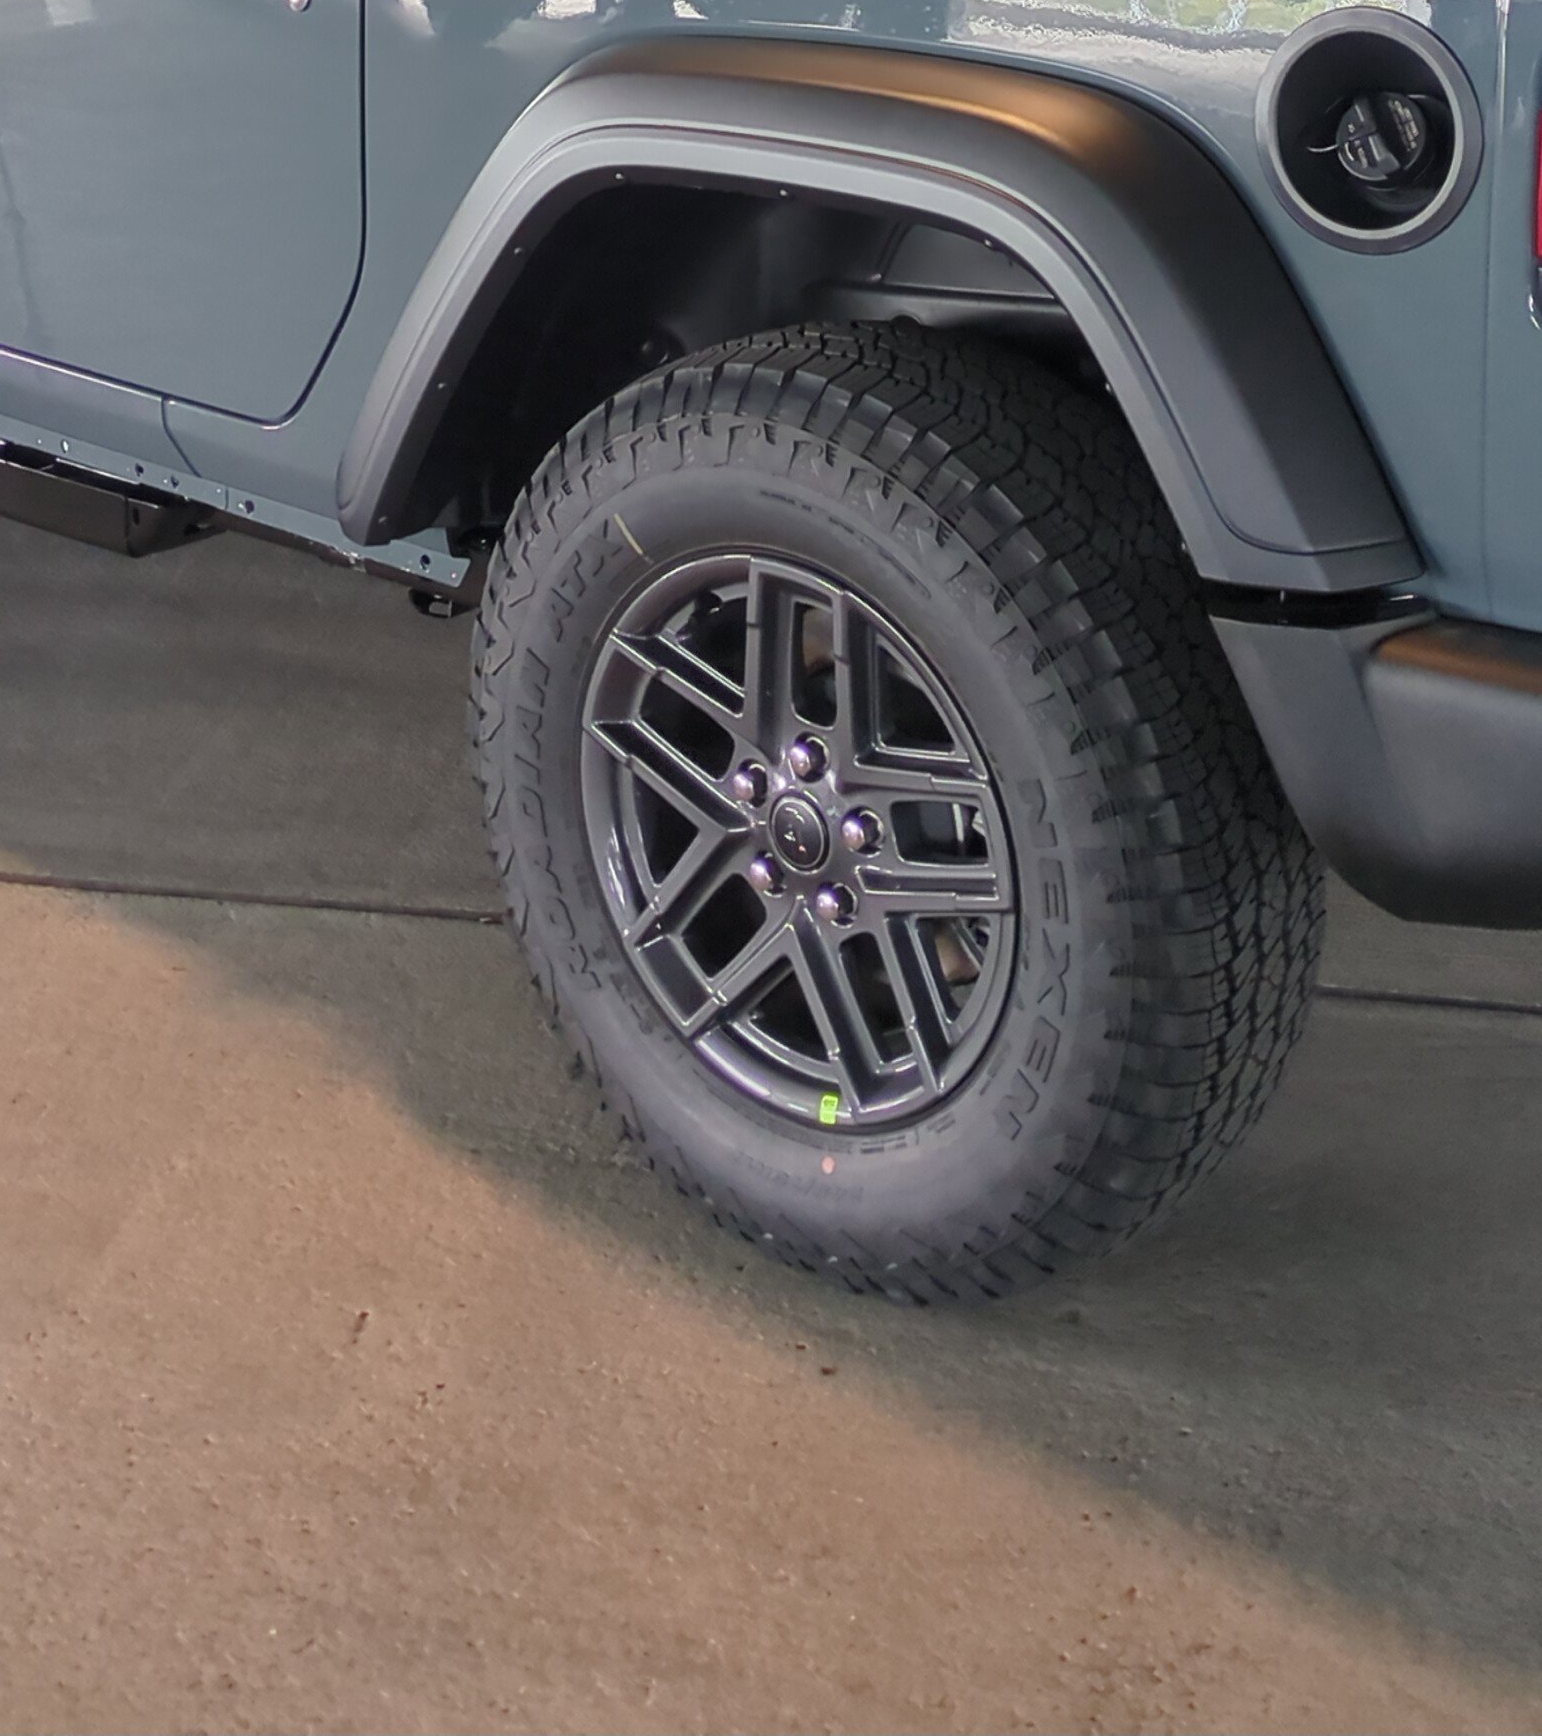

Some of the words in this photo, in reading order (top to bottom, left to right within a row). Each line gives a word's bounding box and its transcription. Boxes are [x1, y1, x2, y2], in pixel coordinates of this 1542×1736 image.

[550, 519, 623, 643] ATX
[515, 647, 602, 989] ROADIAN
[993, 778, 1071, 1142] NEXEN
